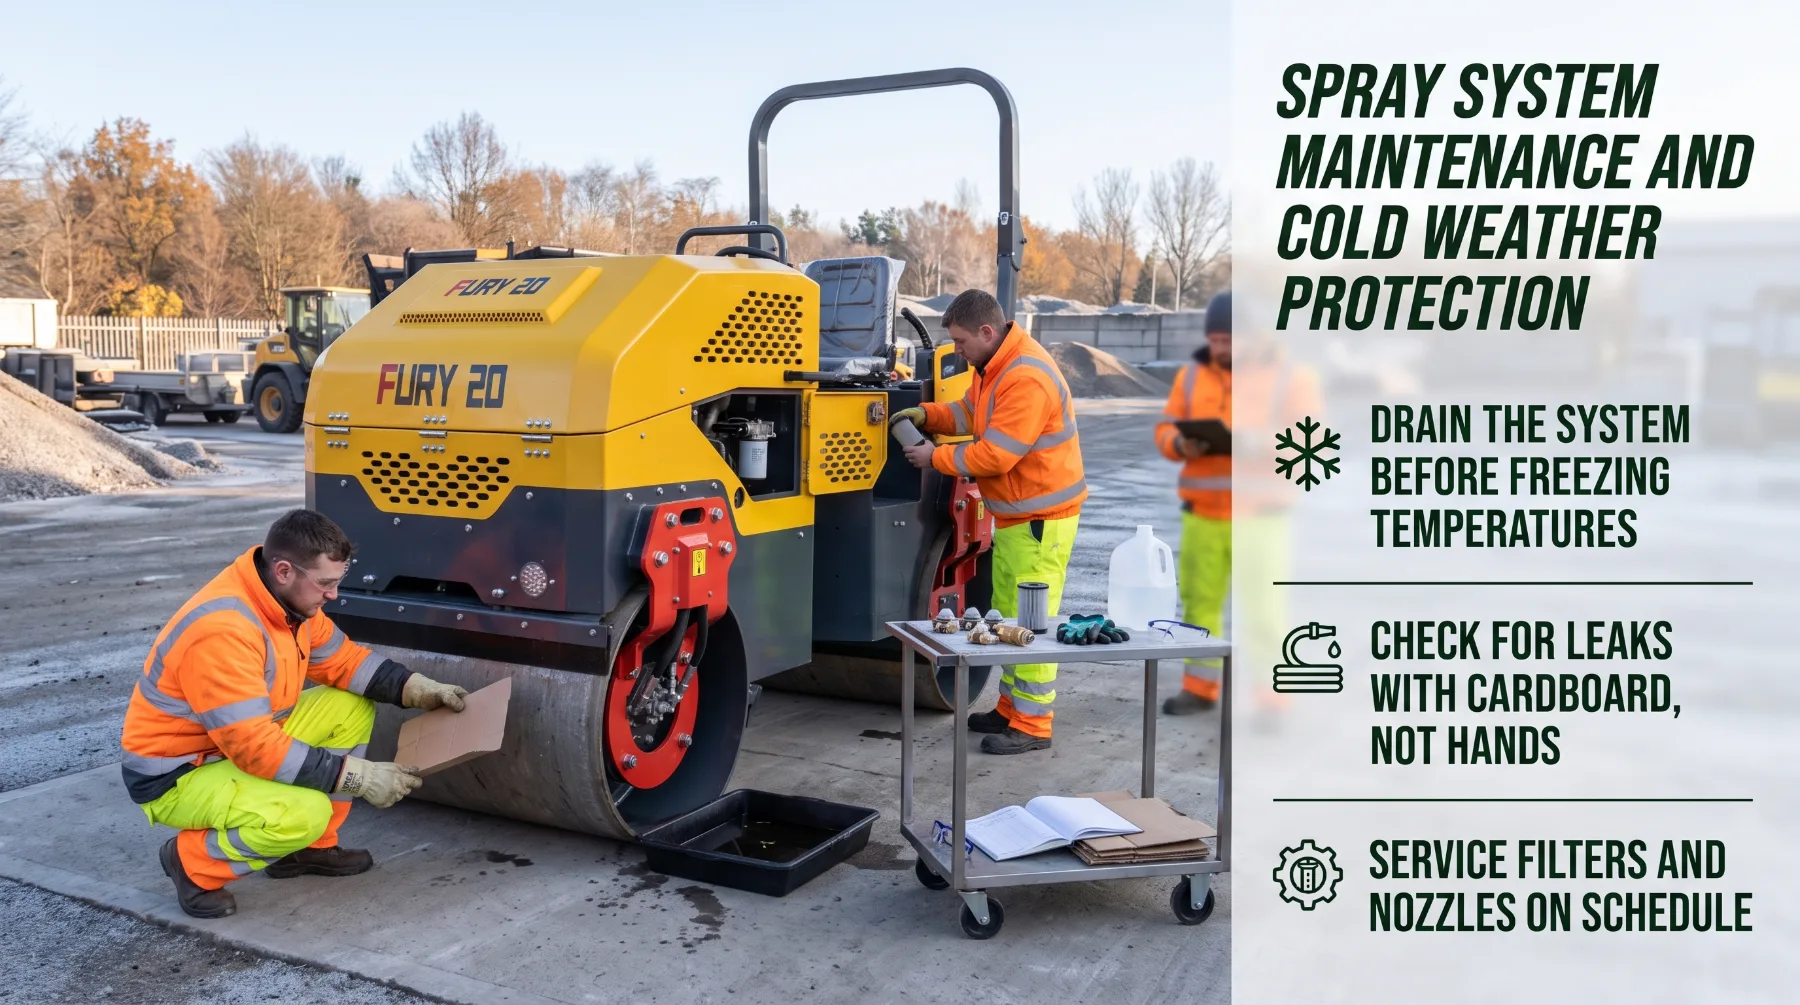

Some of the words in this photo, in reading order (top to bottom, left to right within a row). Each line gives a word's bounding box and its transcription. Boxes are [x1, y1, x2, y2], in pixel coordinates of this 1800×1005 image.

[443, 278, 517, 296] FURY
[508, 277, 551, 295] 20
[376, 363, 459, 407] FURY
[465, 364, 508, 408] 20
